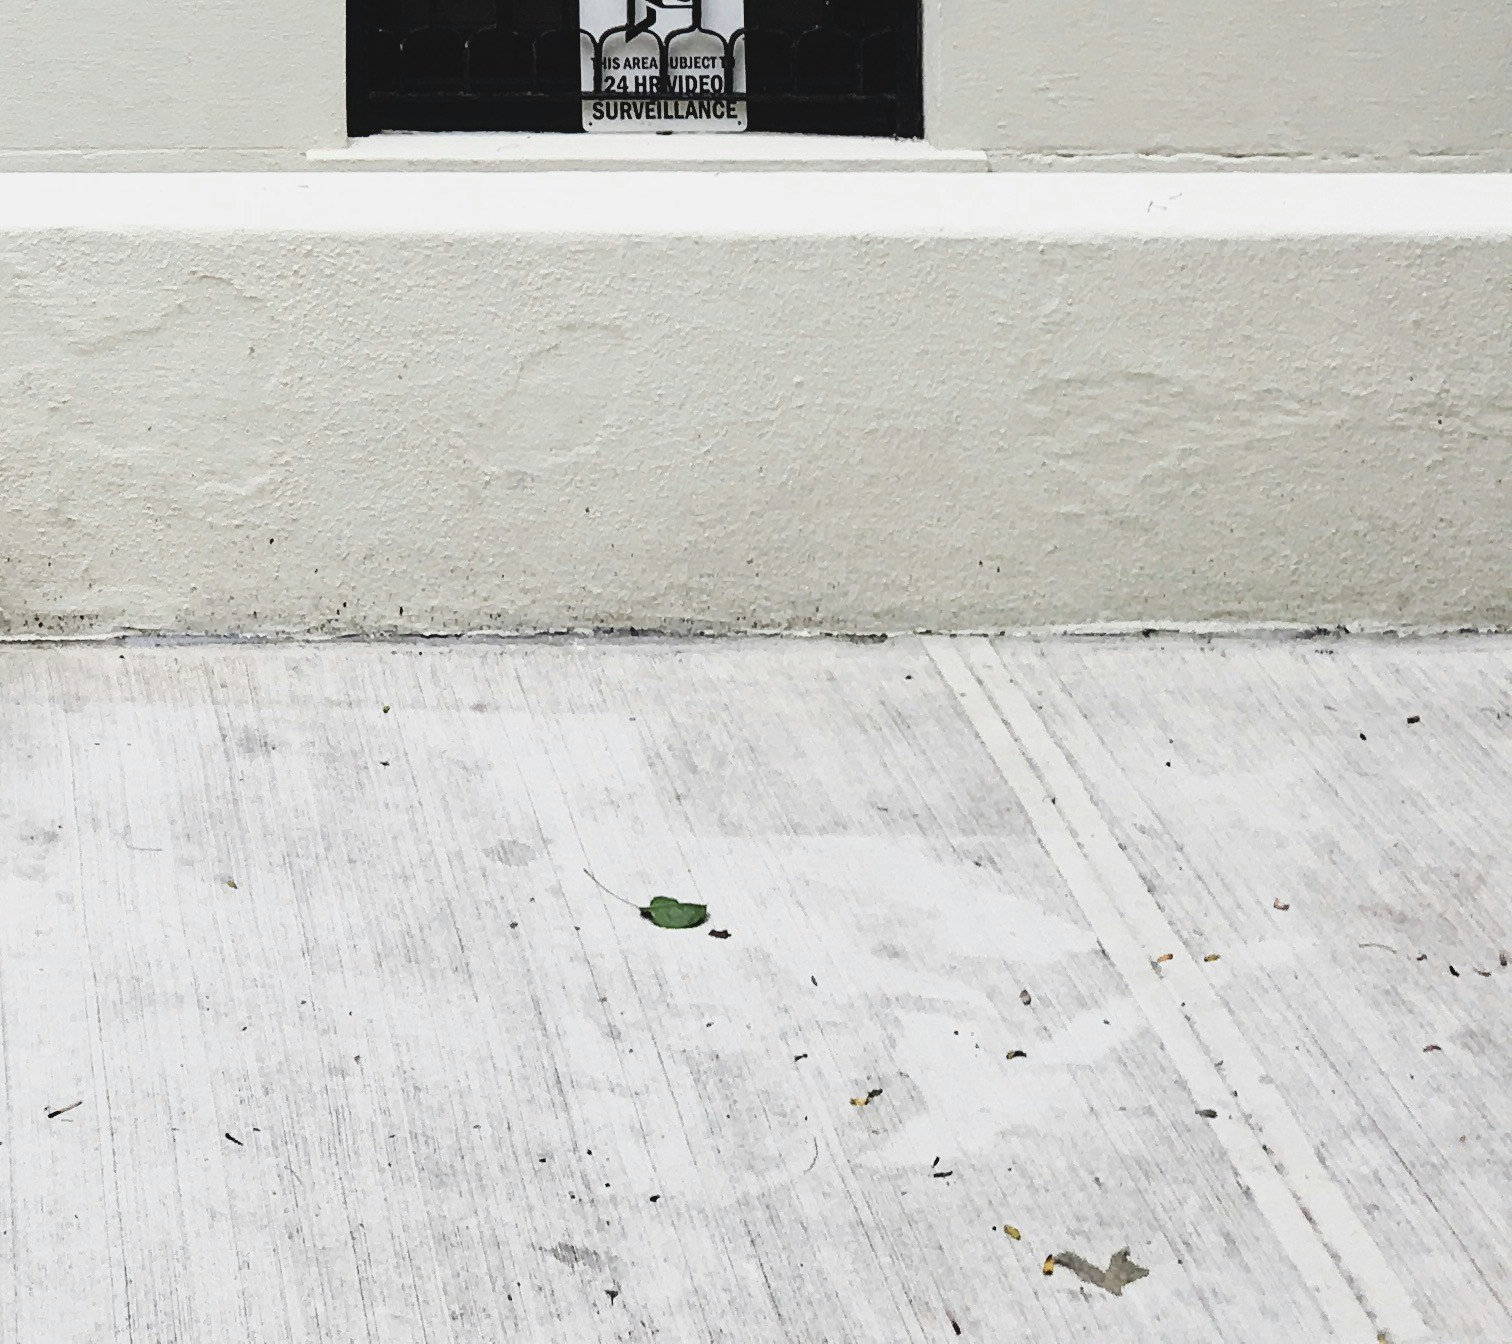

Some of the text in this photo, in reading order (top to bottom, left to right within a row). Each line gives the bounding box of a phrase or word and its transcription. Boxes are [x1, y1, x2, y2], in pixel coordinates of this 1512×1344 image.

[591, 56, 621, 70] HIS
[623, 56, 659, 70] AREA
[669, 56, 717, 70] UBJECT
[603, 75, 629, 94] 24
[666, 74, 724, 94] VIDEO
[592, 100, 738, 121] SURVEILLANCE
